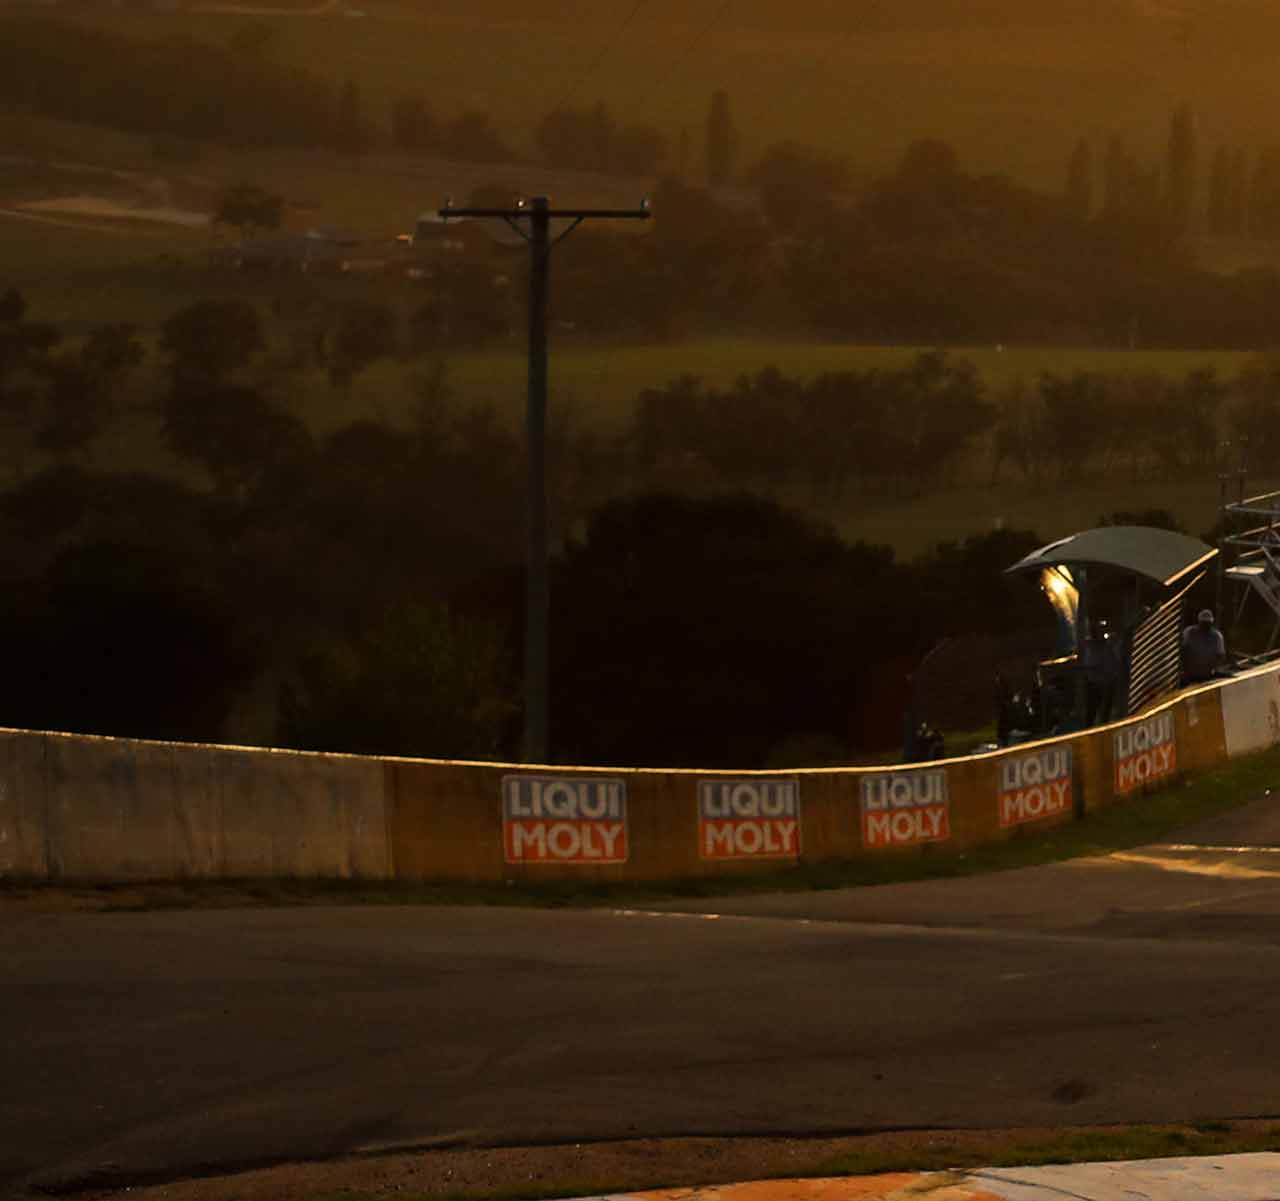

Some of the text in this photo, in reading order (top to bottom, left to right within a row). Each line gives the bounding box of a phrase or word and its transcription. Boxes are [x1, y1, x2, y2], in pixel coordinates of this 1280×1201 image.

[1117, 714, 1172, 758] LIQUI
[1003, 750, 1069, 790] LIQUI
[1117, 748, 1175, 788] MOLY
[510, 780, 620, 818] LIQUI
[704, 783, 795, 817] LIQUI
[863, 774, 946, 809] LIQUI
[1003, 783, 1070, 820] MOLY
[511, 822, 625, 857] MOLY
[705, 822, 798, 855] MOLY
[865, 808, 946, 843] MOLY
